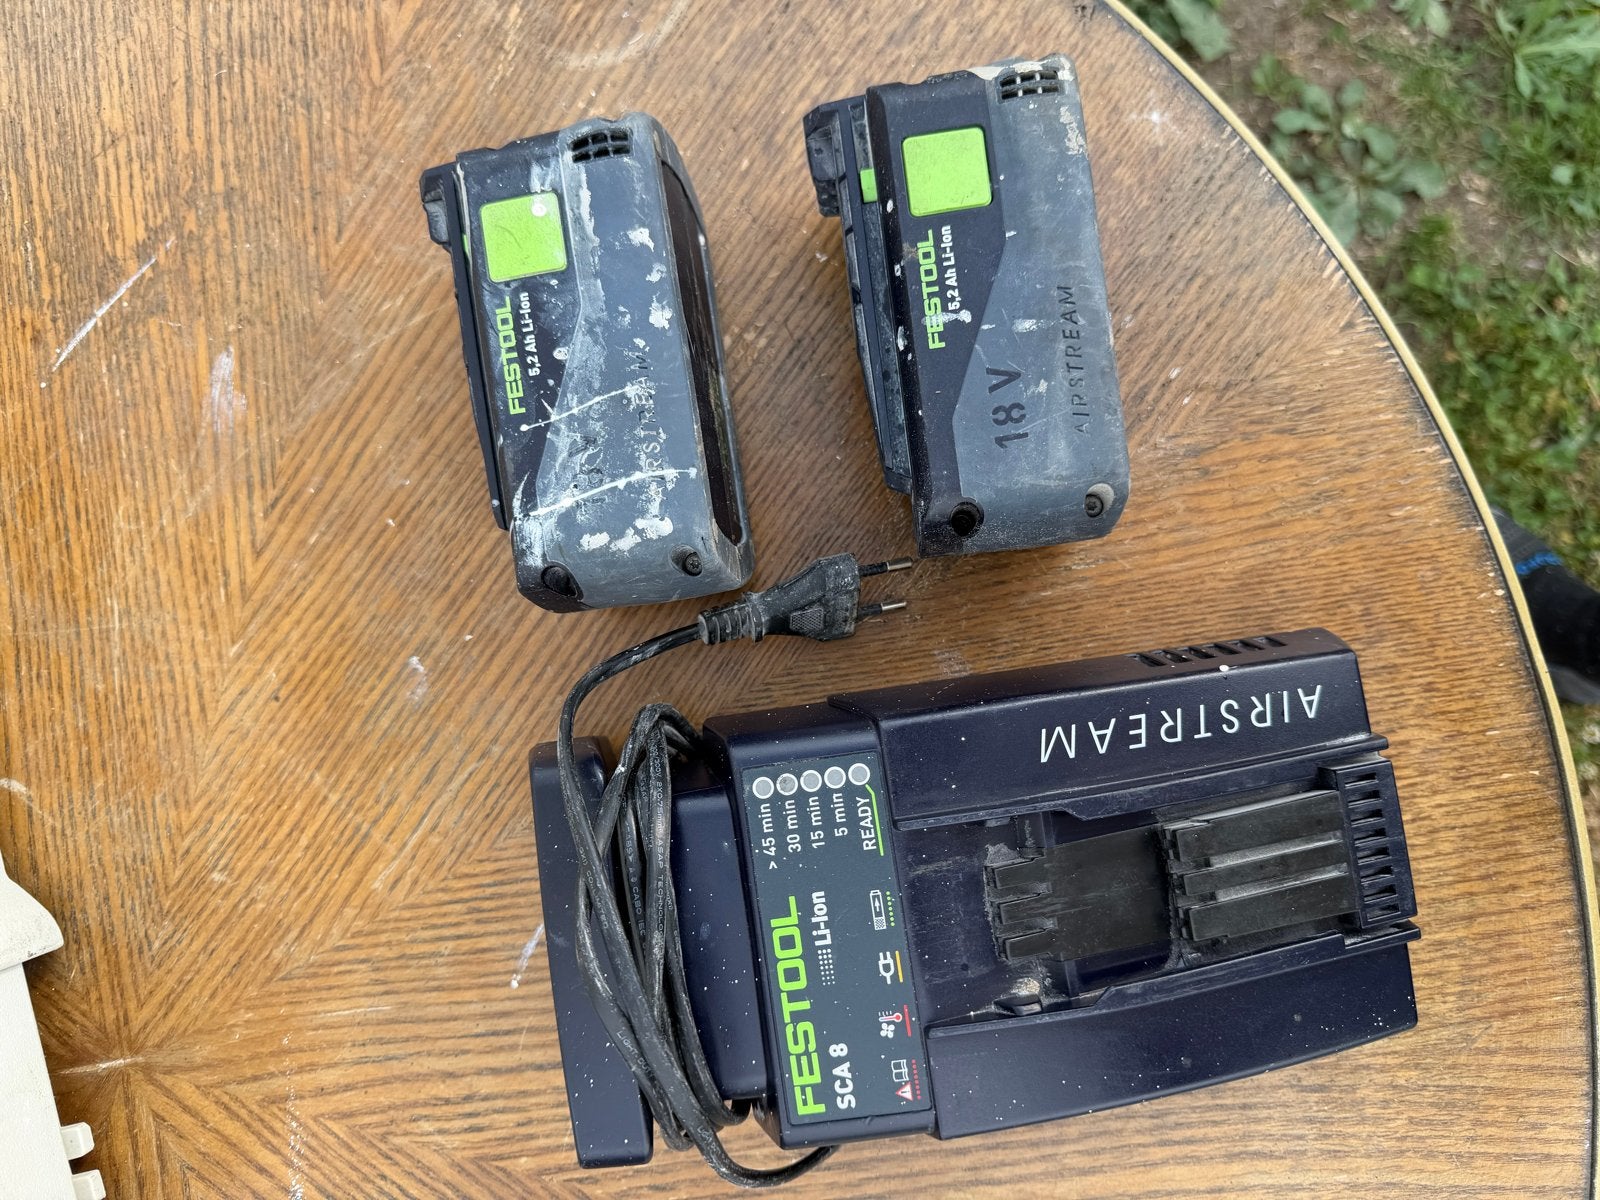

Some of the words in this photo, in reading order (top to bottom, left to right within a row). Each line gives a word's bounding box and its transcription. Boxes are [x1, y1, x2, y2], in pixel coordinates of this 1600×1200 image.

[940, 225, 954, 266] Li-Ion
[917, 230, 945, 349] FESTOOL
[945, 268, 957, 286] Ah
[519, 292, 534, 332] Li-Ion
[947, 289, 961, 310] 5,2
[496, 297, 525, 414] FESTOOL
[522, 335, 537, 352] Ah
[525, 355, 541, 376] 5,2
[1057, 285, 1089, 434] AIRSTREAM
[986, 367, 1021, 393] V
[991, 402, 1028, 448] 18
[1040, 684, 1322, 762] AIRSTREAM
[758, 803, 773, 833] min
[783, 800, 798, 830] min
[807, 797, 822, 826] min
[831, 793, 846, 823] min
[834, 827, 848, 836] 5
[856, 796, 877, 851] READY
[764, 837, 777, 856] 45
[788, 834, 802, 852] 30
[811, 830, 825, 848] 15
[811, 891, 832, 946] Li-Ion
[770, 896, 825, 1115] FESTOOL
[829, 1043, 848, 1057] 8
[832, 1062, 856, 1109] SCA
